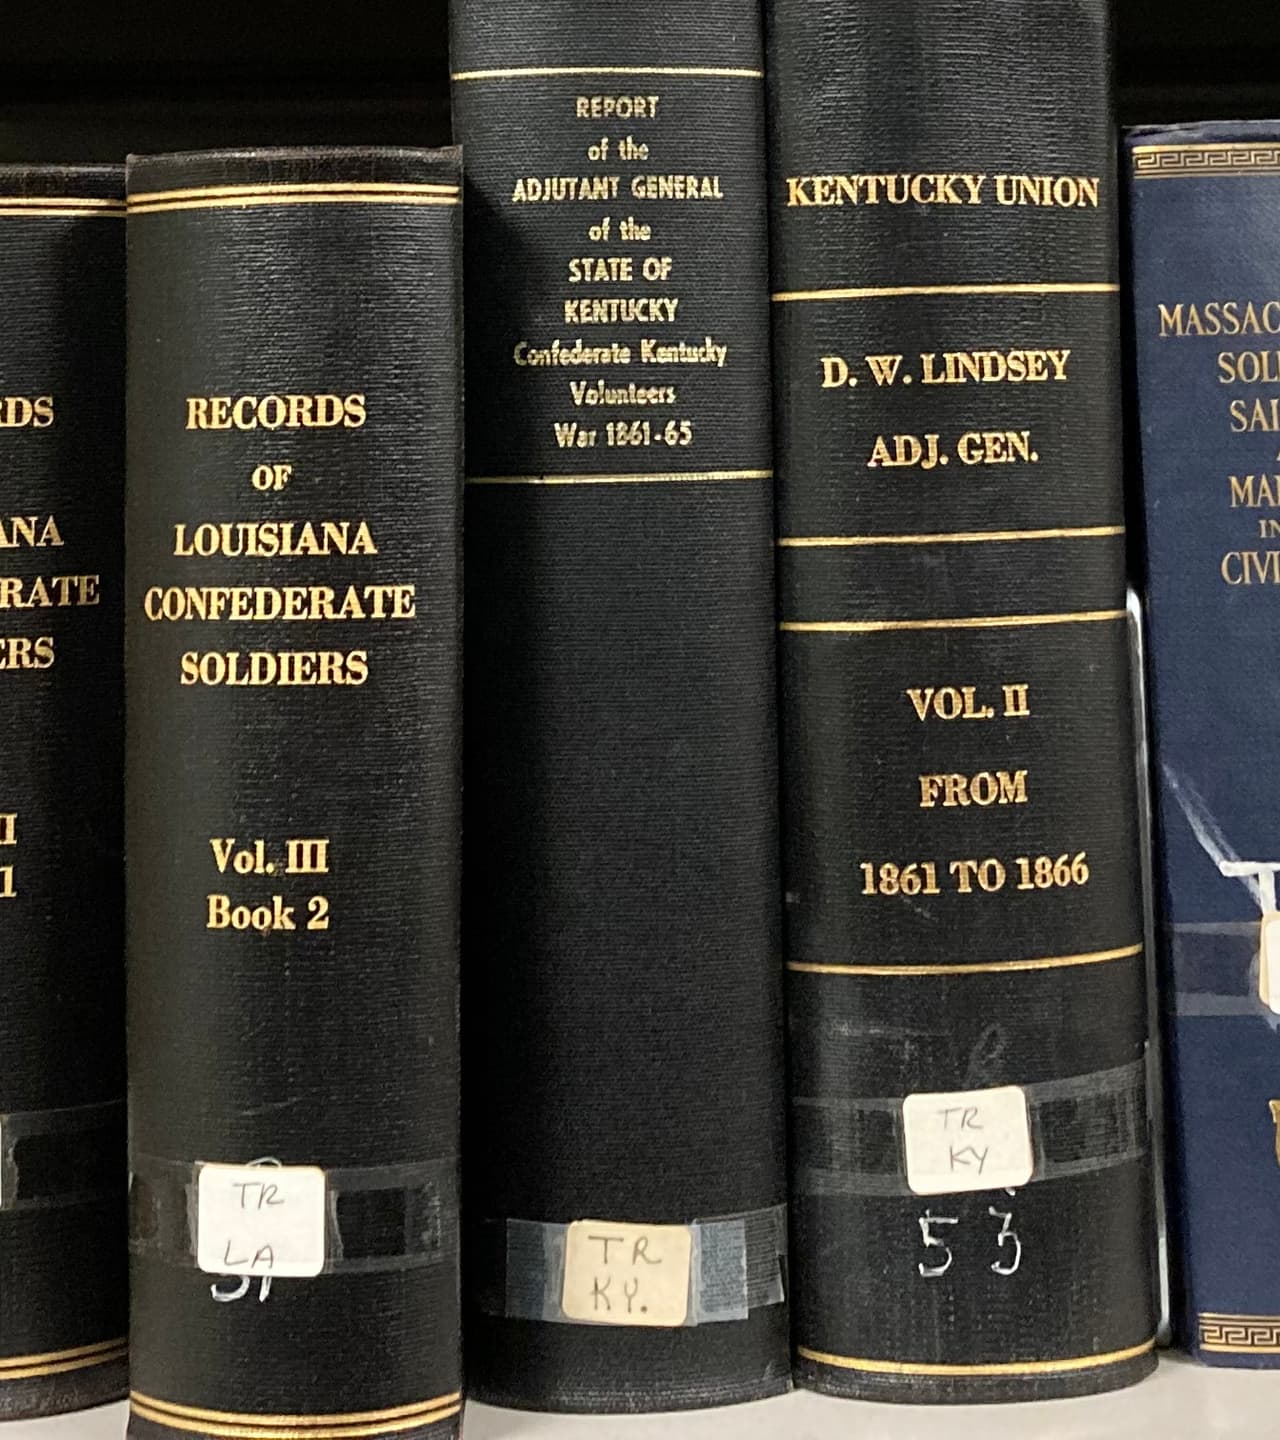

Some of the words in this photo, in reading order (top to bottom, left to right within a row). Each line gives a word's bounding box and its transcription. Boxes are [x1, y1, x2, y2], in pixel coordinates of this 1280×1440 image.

[576, 96, 659, 119] REPORT
[588, 139, 612, 160] of
[619, 138, 649, 160] the
[512, 178, 619, 203] ADJUTANT
[631, 177, 724, 201] GENERAL
[787, 176, 983, 207] KENTUCKY
[995, 175, 1100, 208] UNION
[588, 220, 613, 242] of
[619, 219, 651, 242] the
[567, 258, 633, 283] STATE
[642, 258, 673, 281] OF
[564, 298, 678, 324] KENTUCKY
[513, 342, 631, 366] Confederate
[640, 339, 728, 367] Kentucky
[822, 358, 857, 389] D.
[865, 356, 911, 385] W.
[922, 350, 1071, 383] LINDSEY
[570, 380, 676, 406] Volunteers
[554, 422, 598, 448] War
[605, 420, 693, 447] 1861-65
[867, 436, 948, 468] ADJ.
[957, 431, 1038, 463] GEN.
[907, 687, 994, 720] VOL.
[1002, 684, 1030, 716] II
[919, 771, 1028, 808] FROM
[860, 862, 940, 895] 1861
[951, 861, 1005, 893] TO
[1016, 852, 1089, 890] 1866
[936, 1106, 983, 1129] TR
[948, 1146, 989, 1175] KY
[589, 1235, 662, 1265] TR
[591, 1277, 649, 1314] KY.
